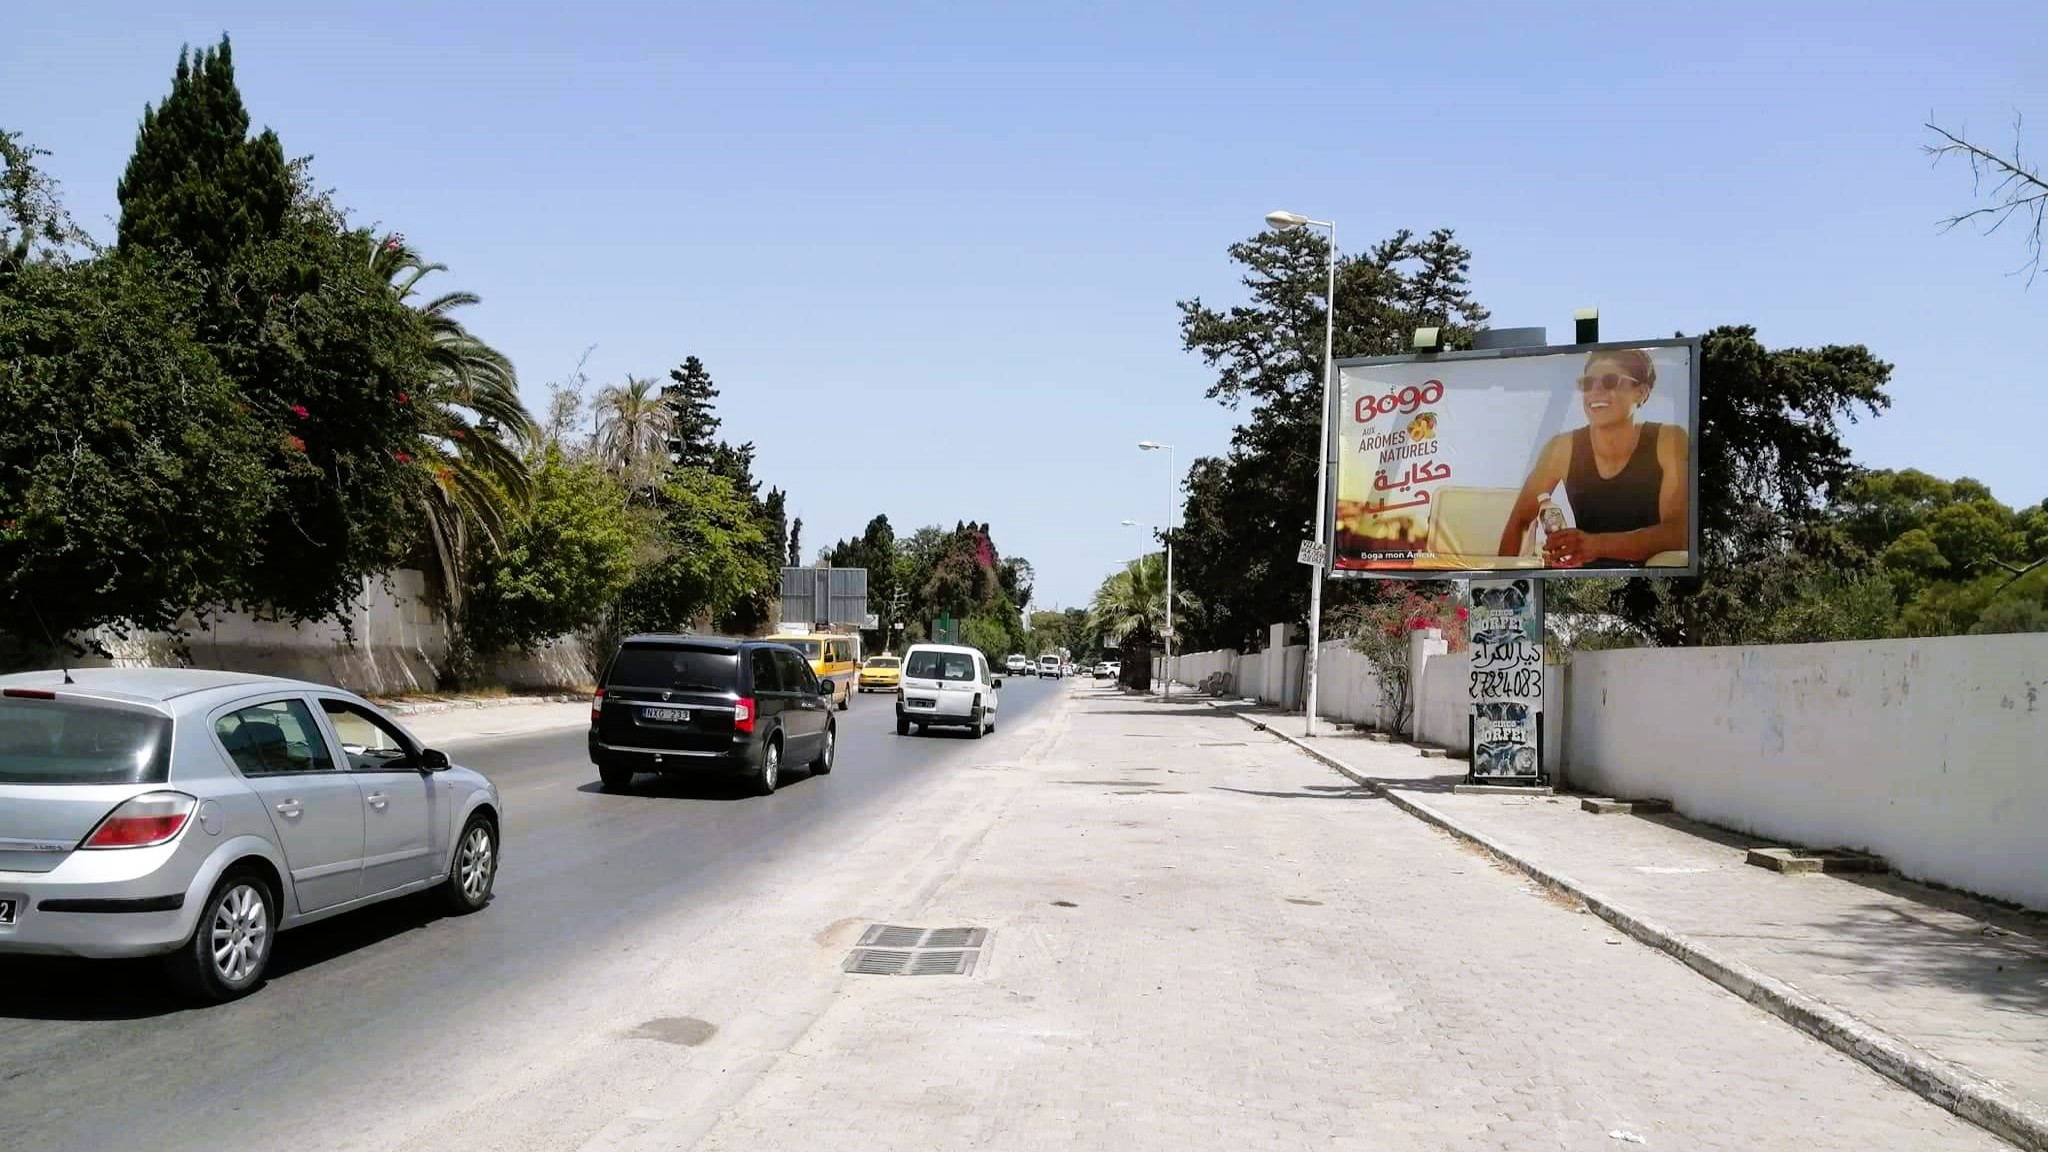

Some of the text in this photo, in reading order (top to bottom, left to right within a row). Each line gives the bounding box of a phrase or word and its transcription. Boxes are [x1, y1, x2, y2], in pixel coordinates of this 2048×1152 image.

[1355, 379, 1444, 423] Boga
[1358, 430, 1406, 453] ARÔMES
[1362, 426, 1376, 437] AUX
[1379, 440, 1438, 464] NATURELS
[1374, 460, 1451, 492] حكاية
[1365, 490, 1430, 518] حب
[1361, 551, 1383, 560] Boga
[1385, 551, 1405, 559] mon
[1482, 617, 1522, 631] ORFEI
[1469, 668, 1541, 698] 27224083
[1484, 727, 1528, 742] ORFEI
